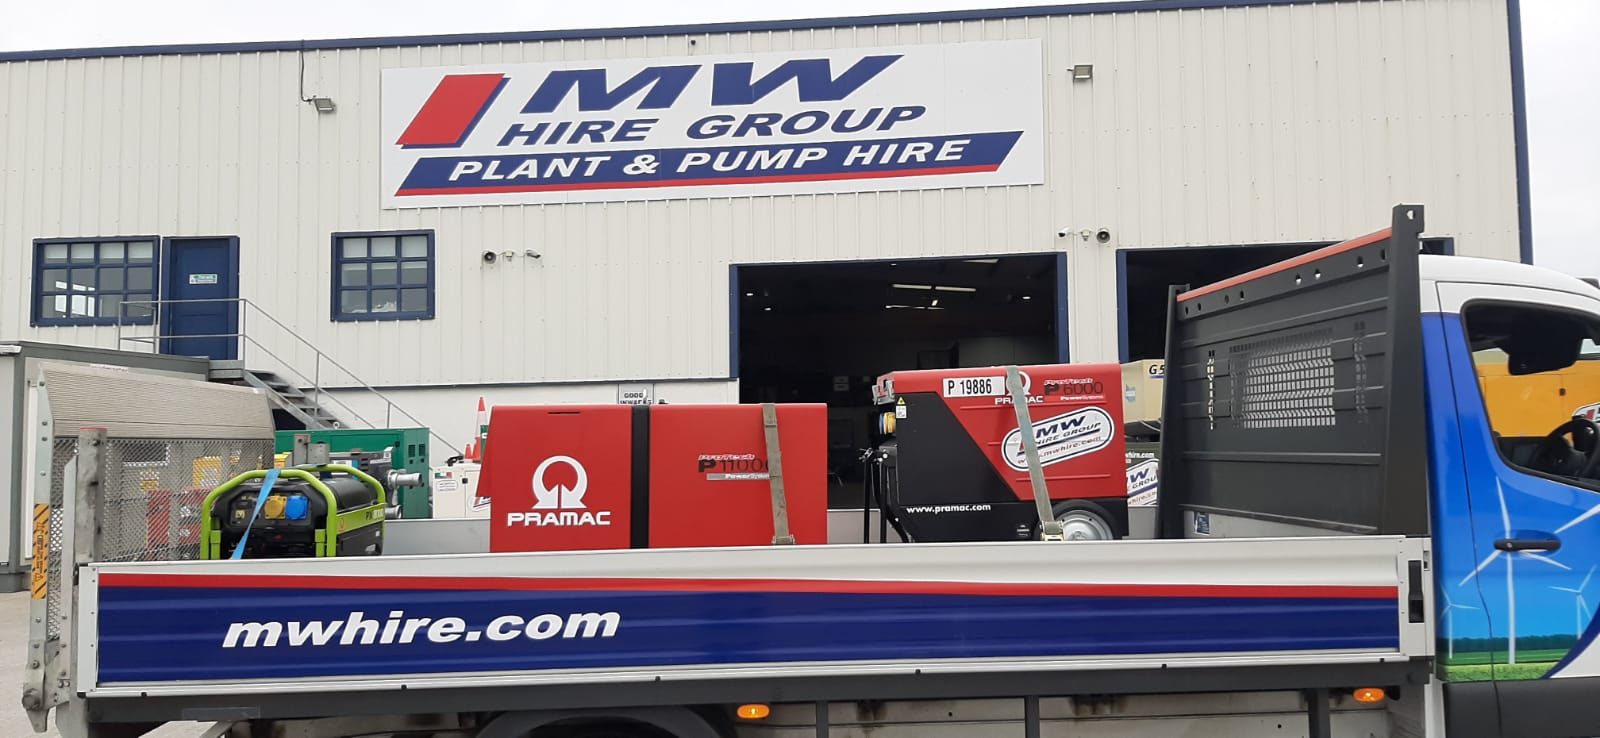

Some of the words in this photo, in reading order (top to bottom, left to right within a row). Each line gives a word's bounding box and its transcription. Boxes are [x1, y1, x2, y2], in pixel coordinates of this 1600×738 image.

[520, 54, 905, 114] MW
[496, 118, 660, 147] HIRE
[686, 105, 927, 140] GROUP
[448, 155, 612, 181] PLANT
[623, 154, 660, 175] &
[676, 147, 828, 173] PUMP
[843, 139, 971, 166] HIRE
[947, 380, 955, 395] P
[960, 378, 992, 395] 19886
[994, 395, 1044, 405] PRAC
[1036, 416, 1085, 438] MW
[1063, 422, 1101, 437] GROUP
[1018, 436, 1101, 464] w.mwhire.com
[1132, 475, 1157, 489] GROU
[507, 511, 611, 527] PRAMAC
[906, 504, 991, 515] www.pramac.com
[222, 610, 621, 648] mwhire.com
